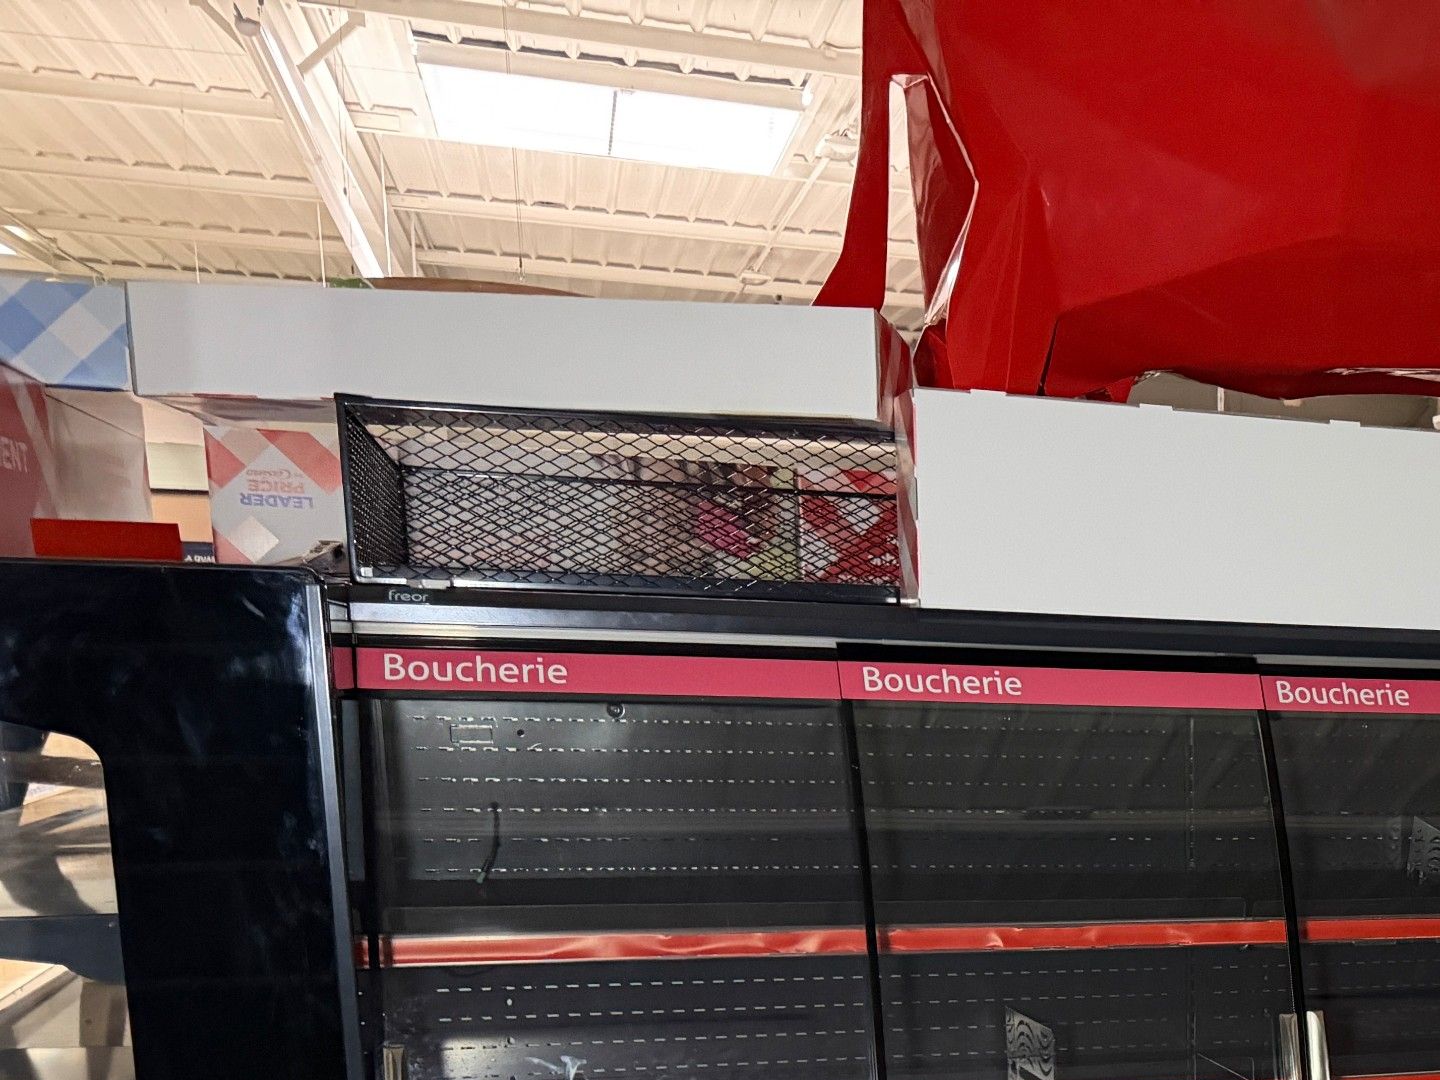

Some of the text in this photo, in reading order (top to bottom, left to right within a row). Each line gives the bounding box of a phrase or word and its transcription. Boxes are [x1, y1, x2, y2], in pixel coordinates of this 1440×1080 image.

[240, 493, 313, 509] LEADER
[388, 589, 428, 602] freor
[384, 654, 568, 684] Boucherie
[863, 667, 1022, 696] Boucherie
[1276, 681, 1410, 706] Boucherie
